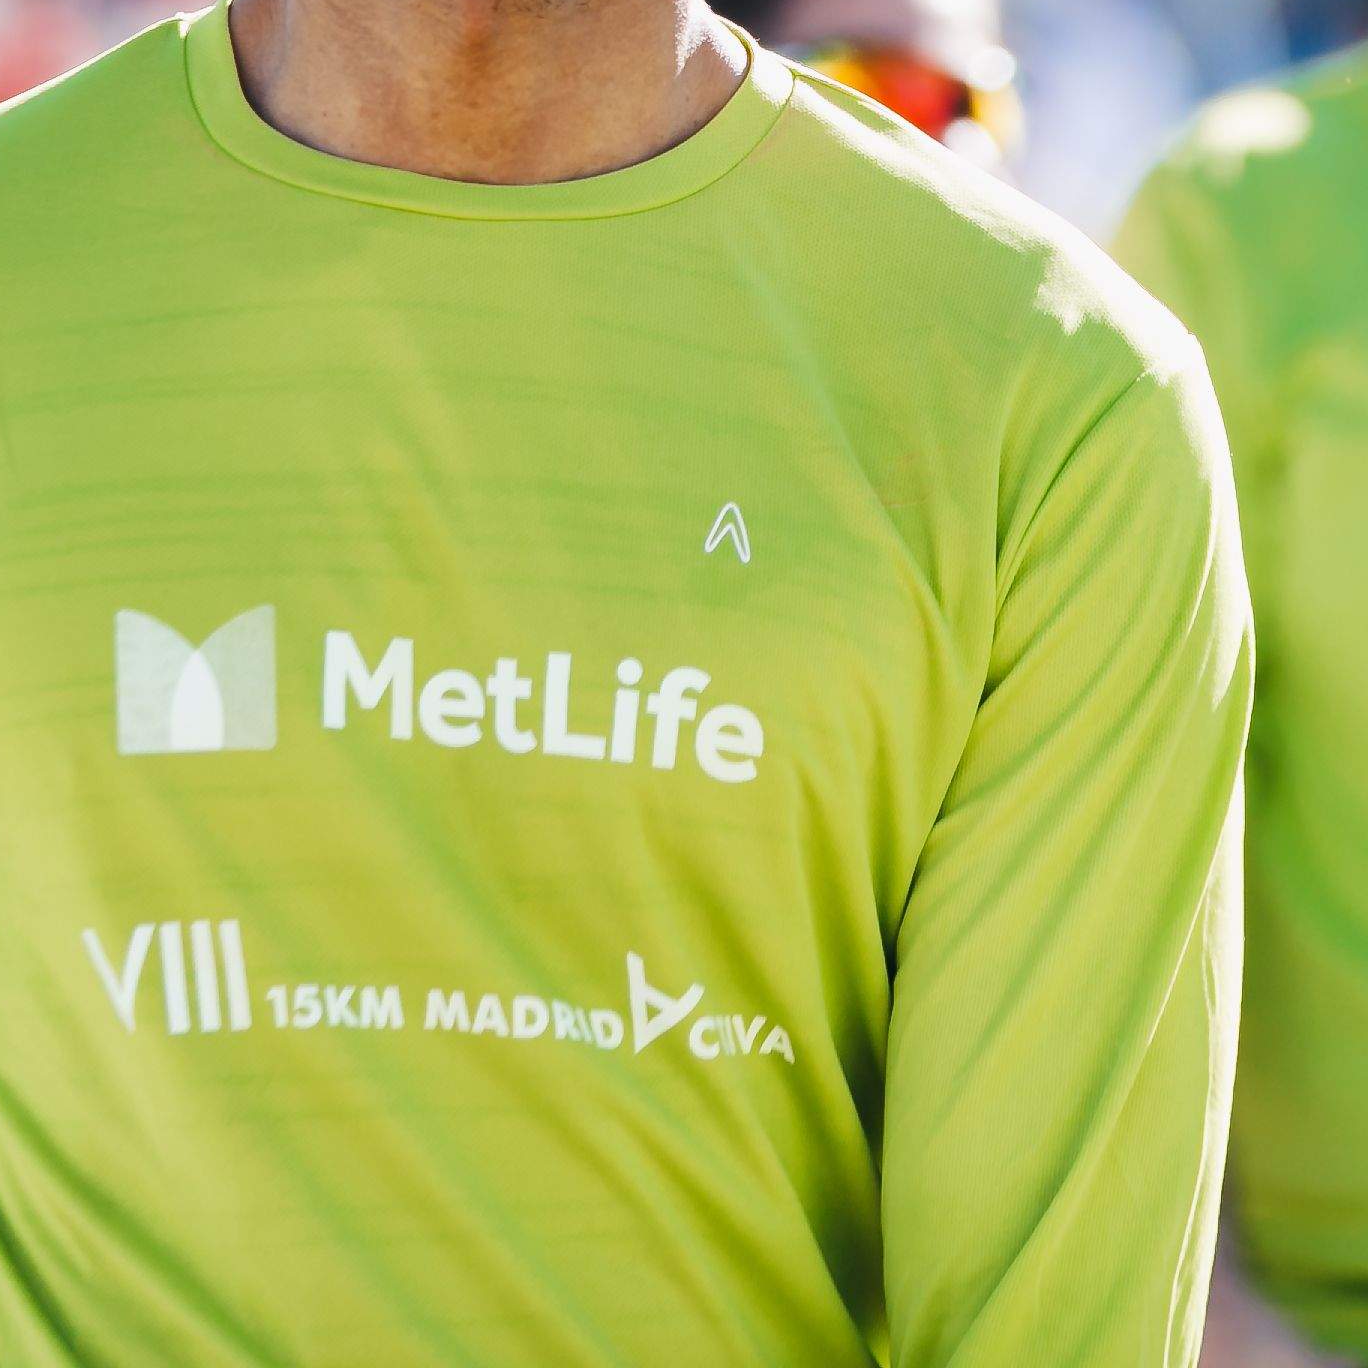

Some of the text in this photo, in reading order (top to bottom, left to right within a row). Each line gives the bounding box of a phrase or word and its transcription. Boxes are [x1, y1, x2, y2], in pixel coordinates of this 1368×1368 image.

[322, 630, 765, 783] MetLife
[82, 919, 252, 1035] VIII
[266, 984, 404, 1030] 15KM
[424, 990, 624, 1050] MADRID
